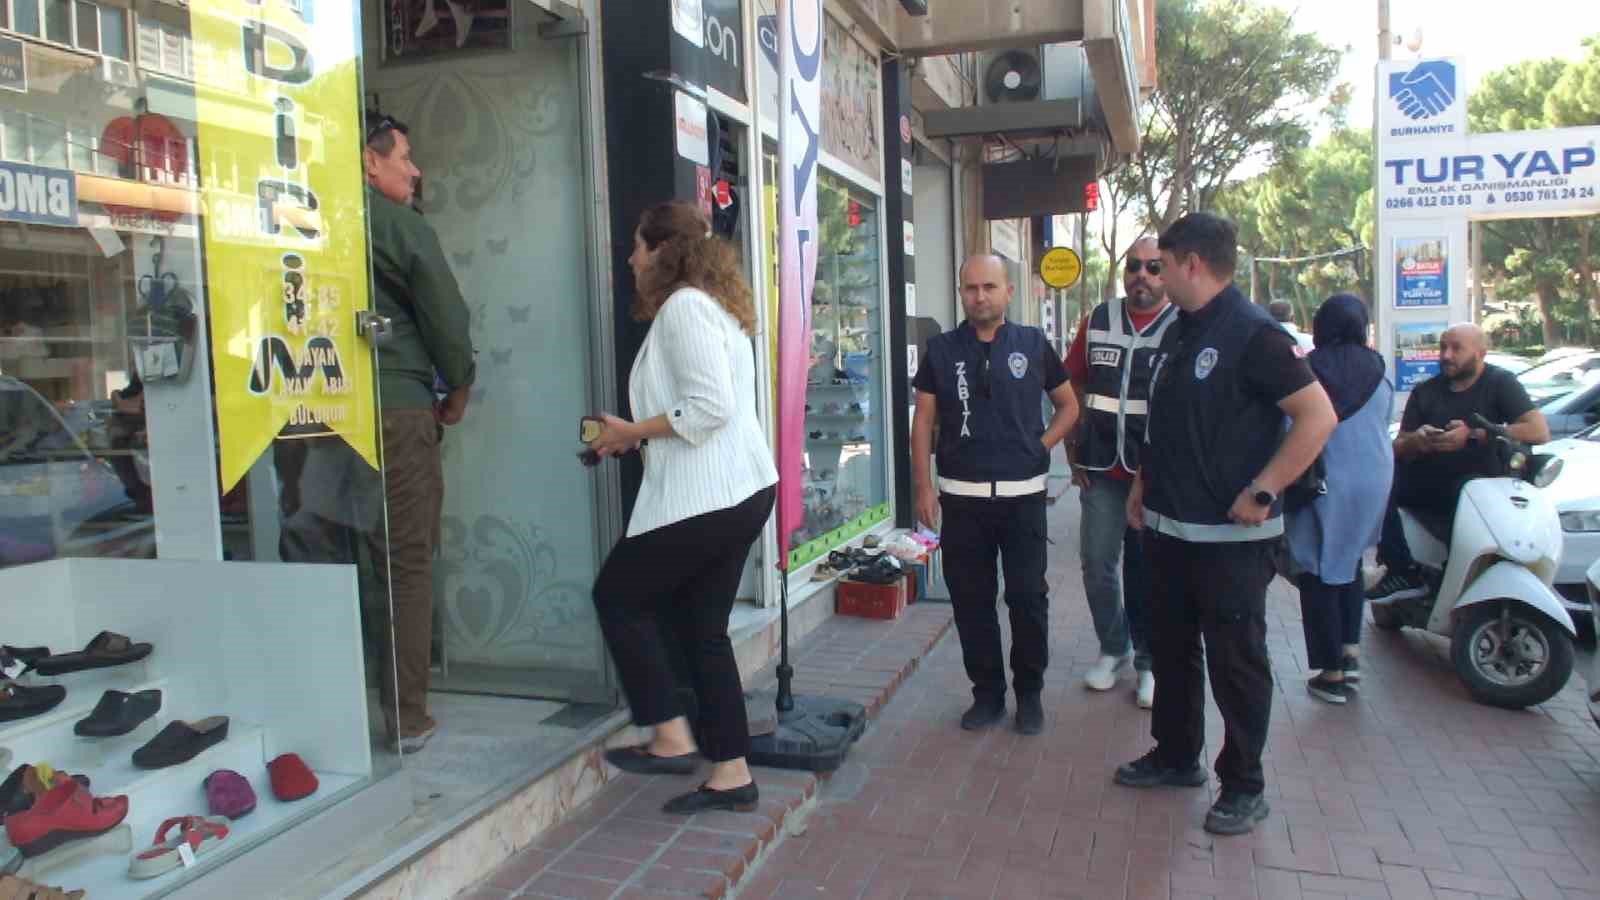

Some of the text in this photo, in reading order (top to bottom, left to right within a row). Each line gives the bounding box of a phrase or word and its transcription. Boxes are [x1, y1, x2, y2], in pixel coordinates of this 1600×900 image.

[1408, 185, 1456, 195] EMLAK
[1416, 196, 1437, 207] 412
[1504, 190, 1534, 203] 0530
[1561, 188, 1576, 199] 24
[1579, 186, 1595, 198] 24
[955, 361, 972, 437] ZABITA
